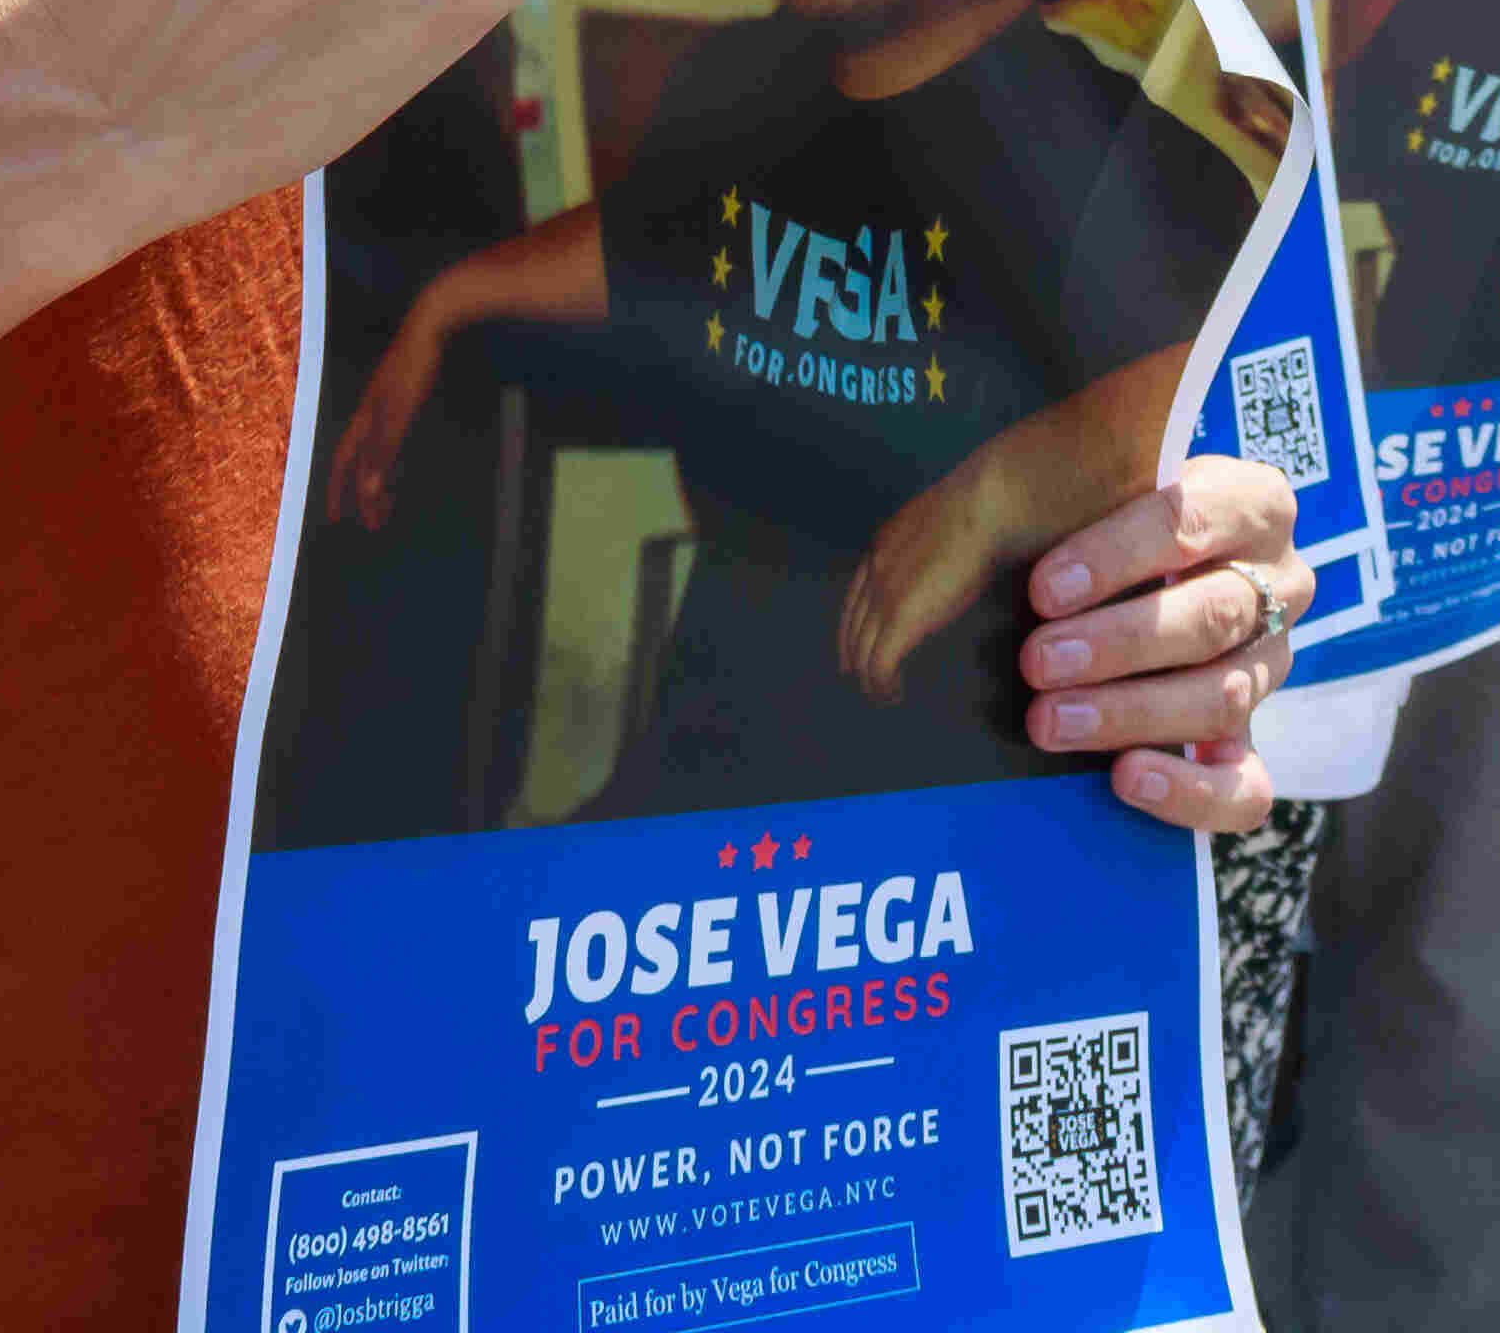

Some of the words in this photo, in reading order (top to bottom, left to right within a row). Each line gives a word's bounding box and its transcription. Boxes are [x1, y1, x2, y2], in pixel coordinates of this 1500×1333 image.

[750, 199, 919, 343] VEGA
[735, 332, 786, 387] FOR
[1376, 430, 1447, 482] SE
[1416, 500, 1478, 532] 2024
[1432, 532, 1479, 561] NOT
[524, 895, 739, 1025] JOSE
[757, 870, 975, 978] VEGA
[535, 1013, 641, 1072] FOR
[671, 971, 950, 1052] CONGRESS
[698, 1054, 796, 1107] 2024
[1057, 1113, 1098, 1133] JOSE
[1058, 1131, 1101, 1151] VEGA
[553, 1146, 712, 1206] POWER,
[730, 1128, 807, 1176] NOT
[823, 1108, 940, 1161] FORCE
[341, 1183, 403, 1209] Contact:
[601, 1175, 896, 1246] WWW.VOTEVEGA.NYC
[288, 1225, 349, 1265] (800)
[352, 1212, 450, 1253] 498-8561
[285, 1271, 337, 1296] Follow
[336, 1265, 369, 1290] Jose
[370, 1262, 390, 1279] on
[589, 1289, 639, 1328] Paid
[644, 1285, 674, 1316] for
[680, 1282, 708, 1316] by
[712, 1275, 765, 1307] Vega
[769, 1264, 800, 1294] for
[804, 1251, 898, 1287] Congress
